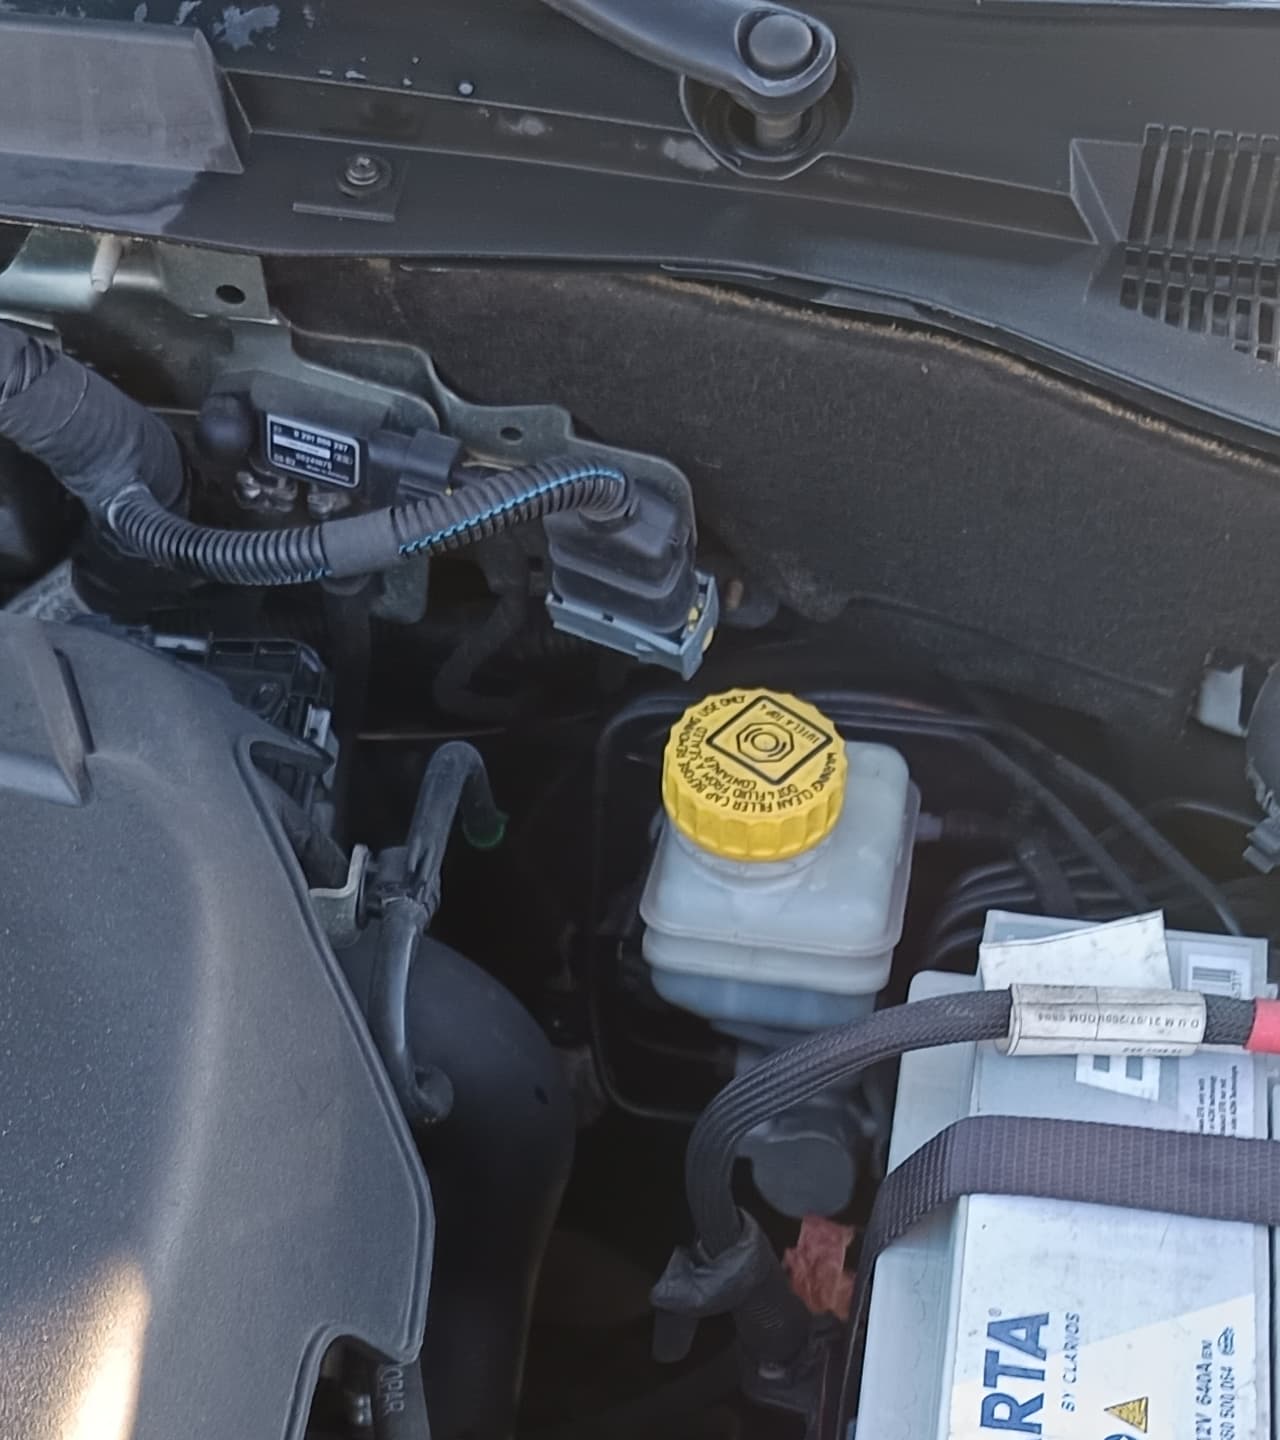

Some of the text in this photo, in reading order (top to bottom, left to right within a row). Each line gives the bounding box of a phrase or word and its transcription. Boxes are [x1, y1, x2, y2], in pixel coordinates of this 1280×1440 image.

[675, 694, 838, 814] WARNING CLEAN FILLER CAP BEFORE REMOVING USE ONLY
[688, 725, 709, 762] SEALED
[701, 771, 731, 793] FROM
[703, 754, 758, 791] CONTAINER
[732, 787, 766, 802] FLUID
[1060, 1312, 1080, 1413] BY CLARIOS
